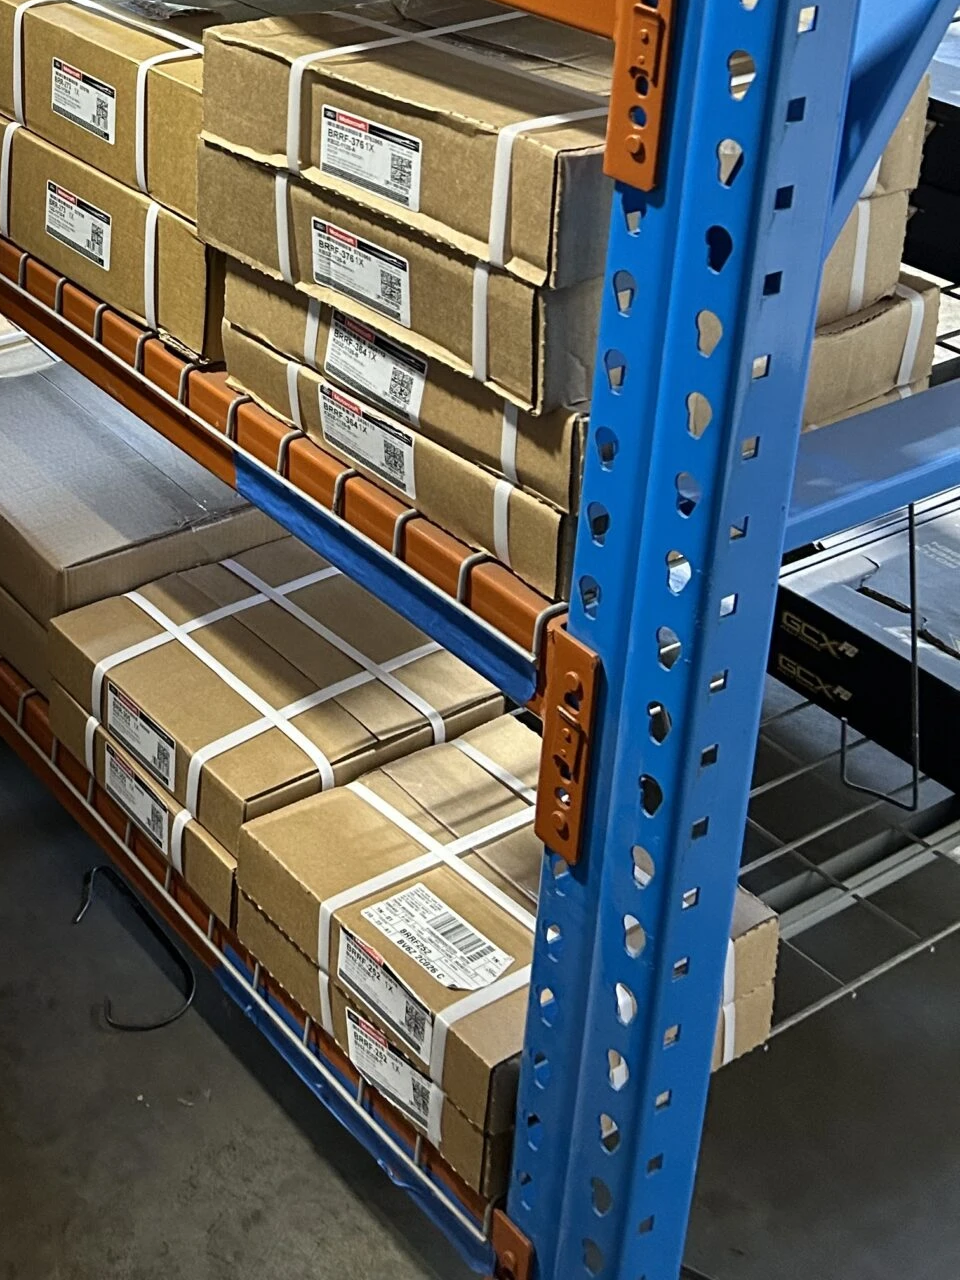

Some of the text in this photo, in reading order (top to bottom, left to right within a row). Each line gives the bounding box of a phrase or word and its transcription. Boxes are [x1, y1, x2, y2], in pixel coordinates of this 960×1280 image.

[327, 128, 364, 150] BRRF-376
[782, 611, 840, 659] GCX
[397, 939, 417, 954] BV6Z
[400, 928, 432, 955] BRRF252
[346, 943, 381, 981] BRRF-252
[353, 1031, 388, 1064] BRRF-252
